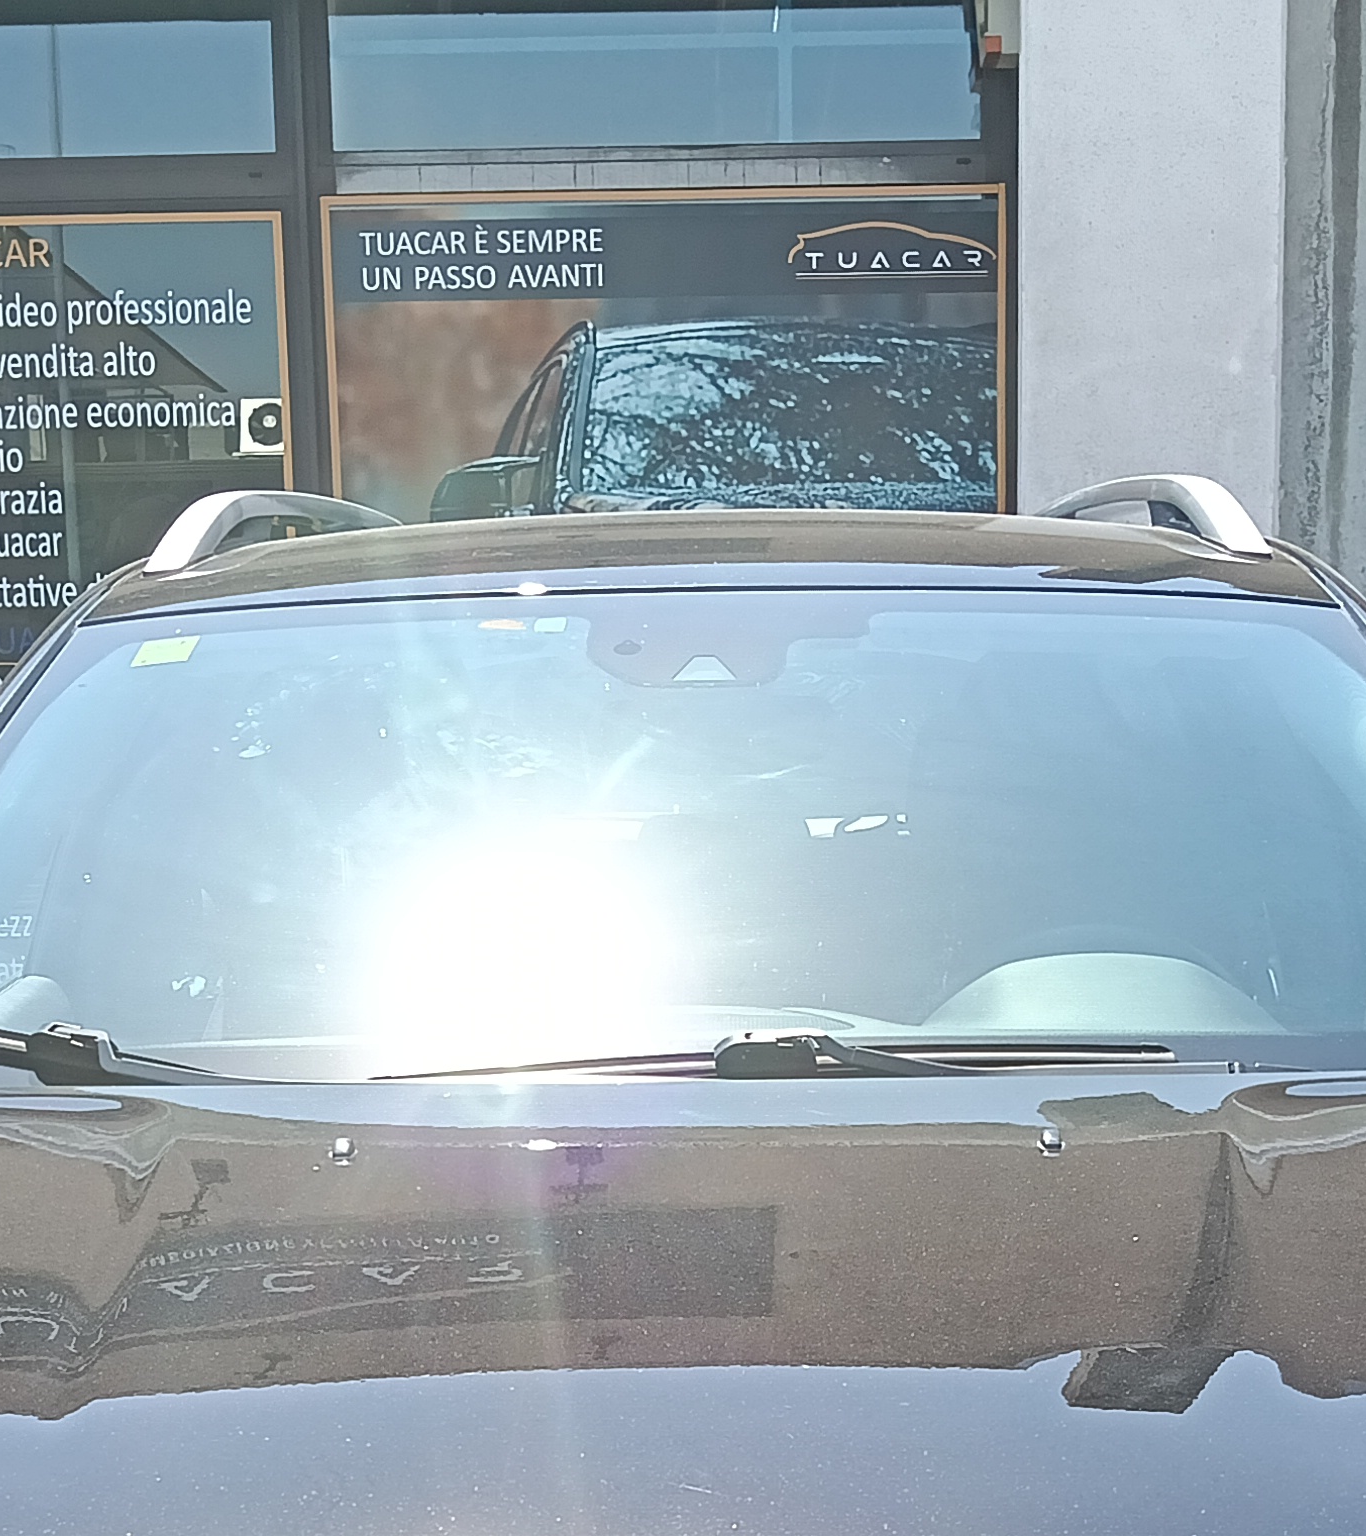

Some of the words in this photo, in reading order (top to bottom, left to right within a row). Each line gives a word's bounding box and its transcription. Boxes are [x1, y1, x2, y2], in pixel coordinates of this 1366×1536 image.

[359, 231, 466, 256] TUACAR
[475, 224, 489, 254] È
[496, 228, 603, 254] SEMPRE
[804, 249, 984, 270] TUACAR
[362, 266, 401, 291] UN
[415, 265, 496, 290] PASSO
[508, 263, 603, 289] AVANTI
[67, 288, 253, 334] professionale
[103, 341, 156, 377] alto
[86, 393, 235, 428] economica
